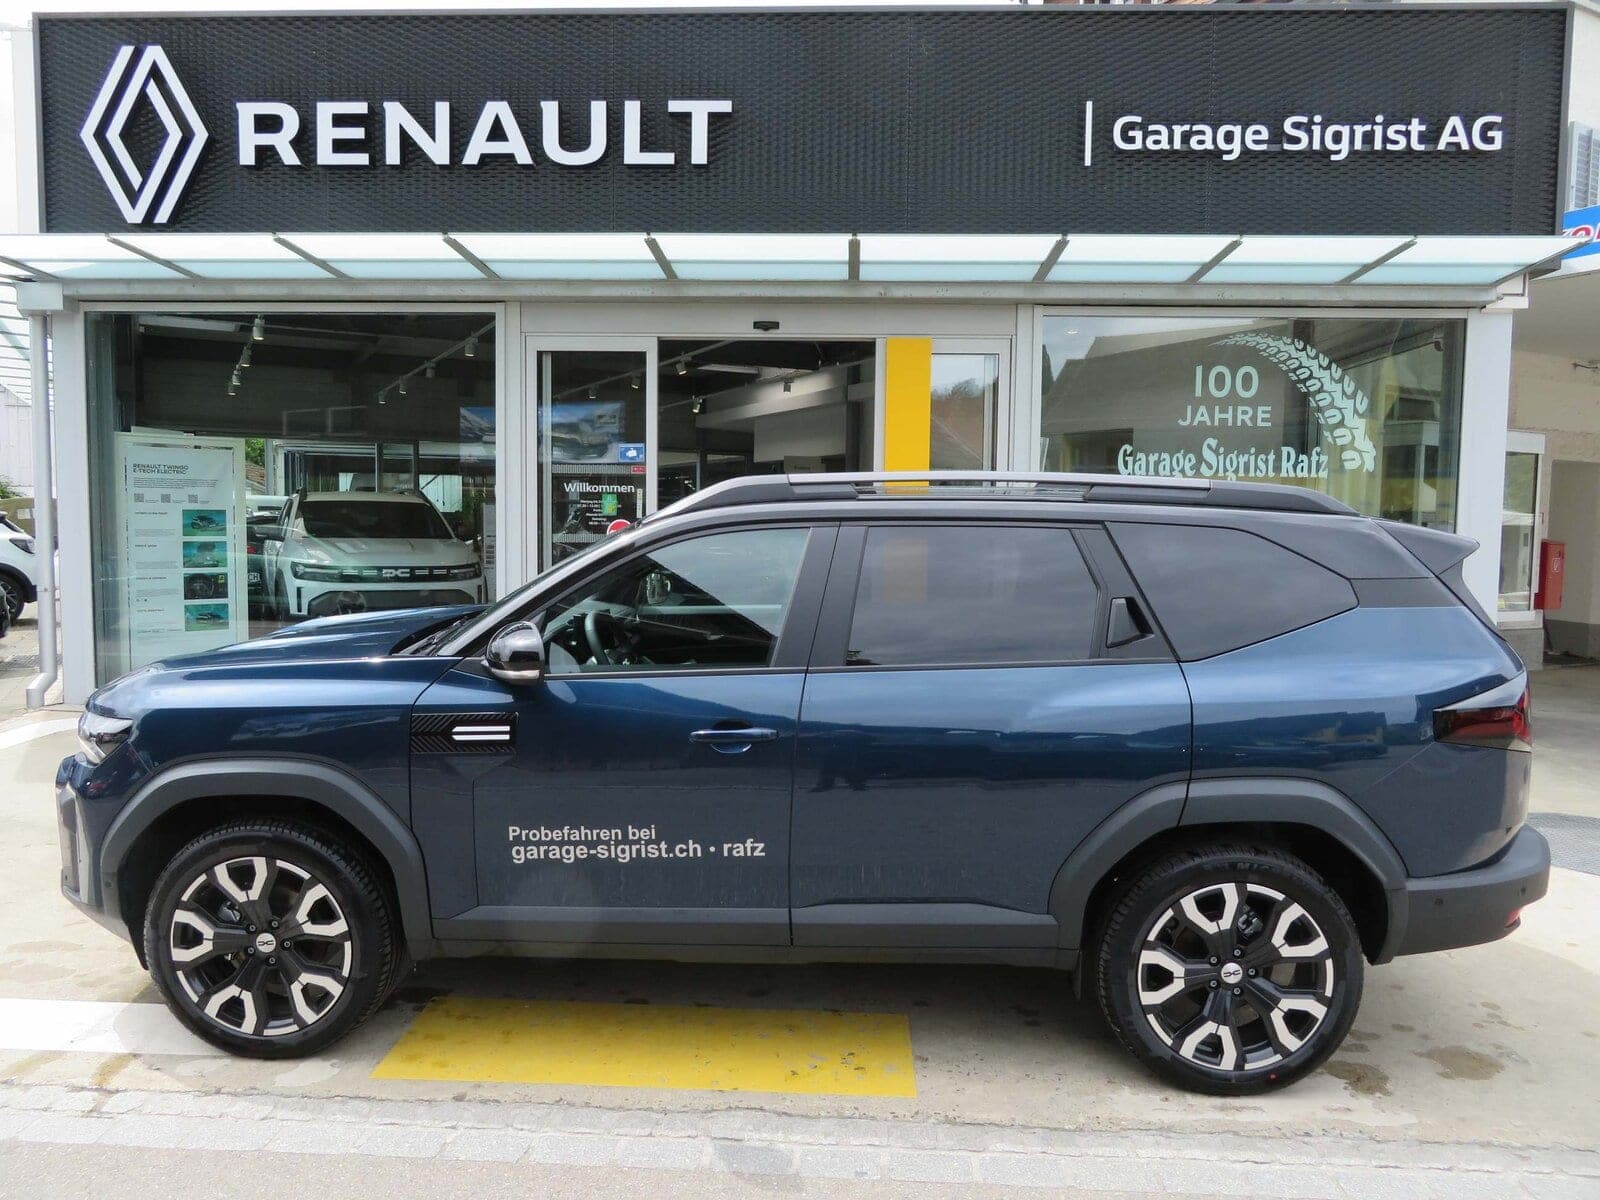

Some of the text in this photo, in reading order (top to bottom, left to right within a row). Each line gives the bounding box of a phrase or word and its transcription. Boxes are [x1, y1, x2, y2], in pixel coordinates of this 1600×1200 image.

[236, 100, 734, 167] RENAULT
[1112, 114, 1504, 161] Garage Sigrist AG
[1194, 365, 1260, 400] 100
[1177, 405, 1273, 428] JAHRE
[1117, 437, 1329, 481] Garage Sigrist Rafz
[563, 482, 636, 493] Willkommen
[508, 825, 657, 842] Probefahren bei
[511, 838, 767, 863] garage-sigrist.ch rafz
